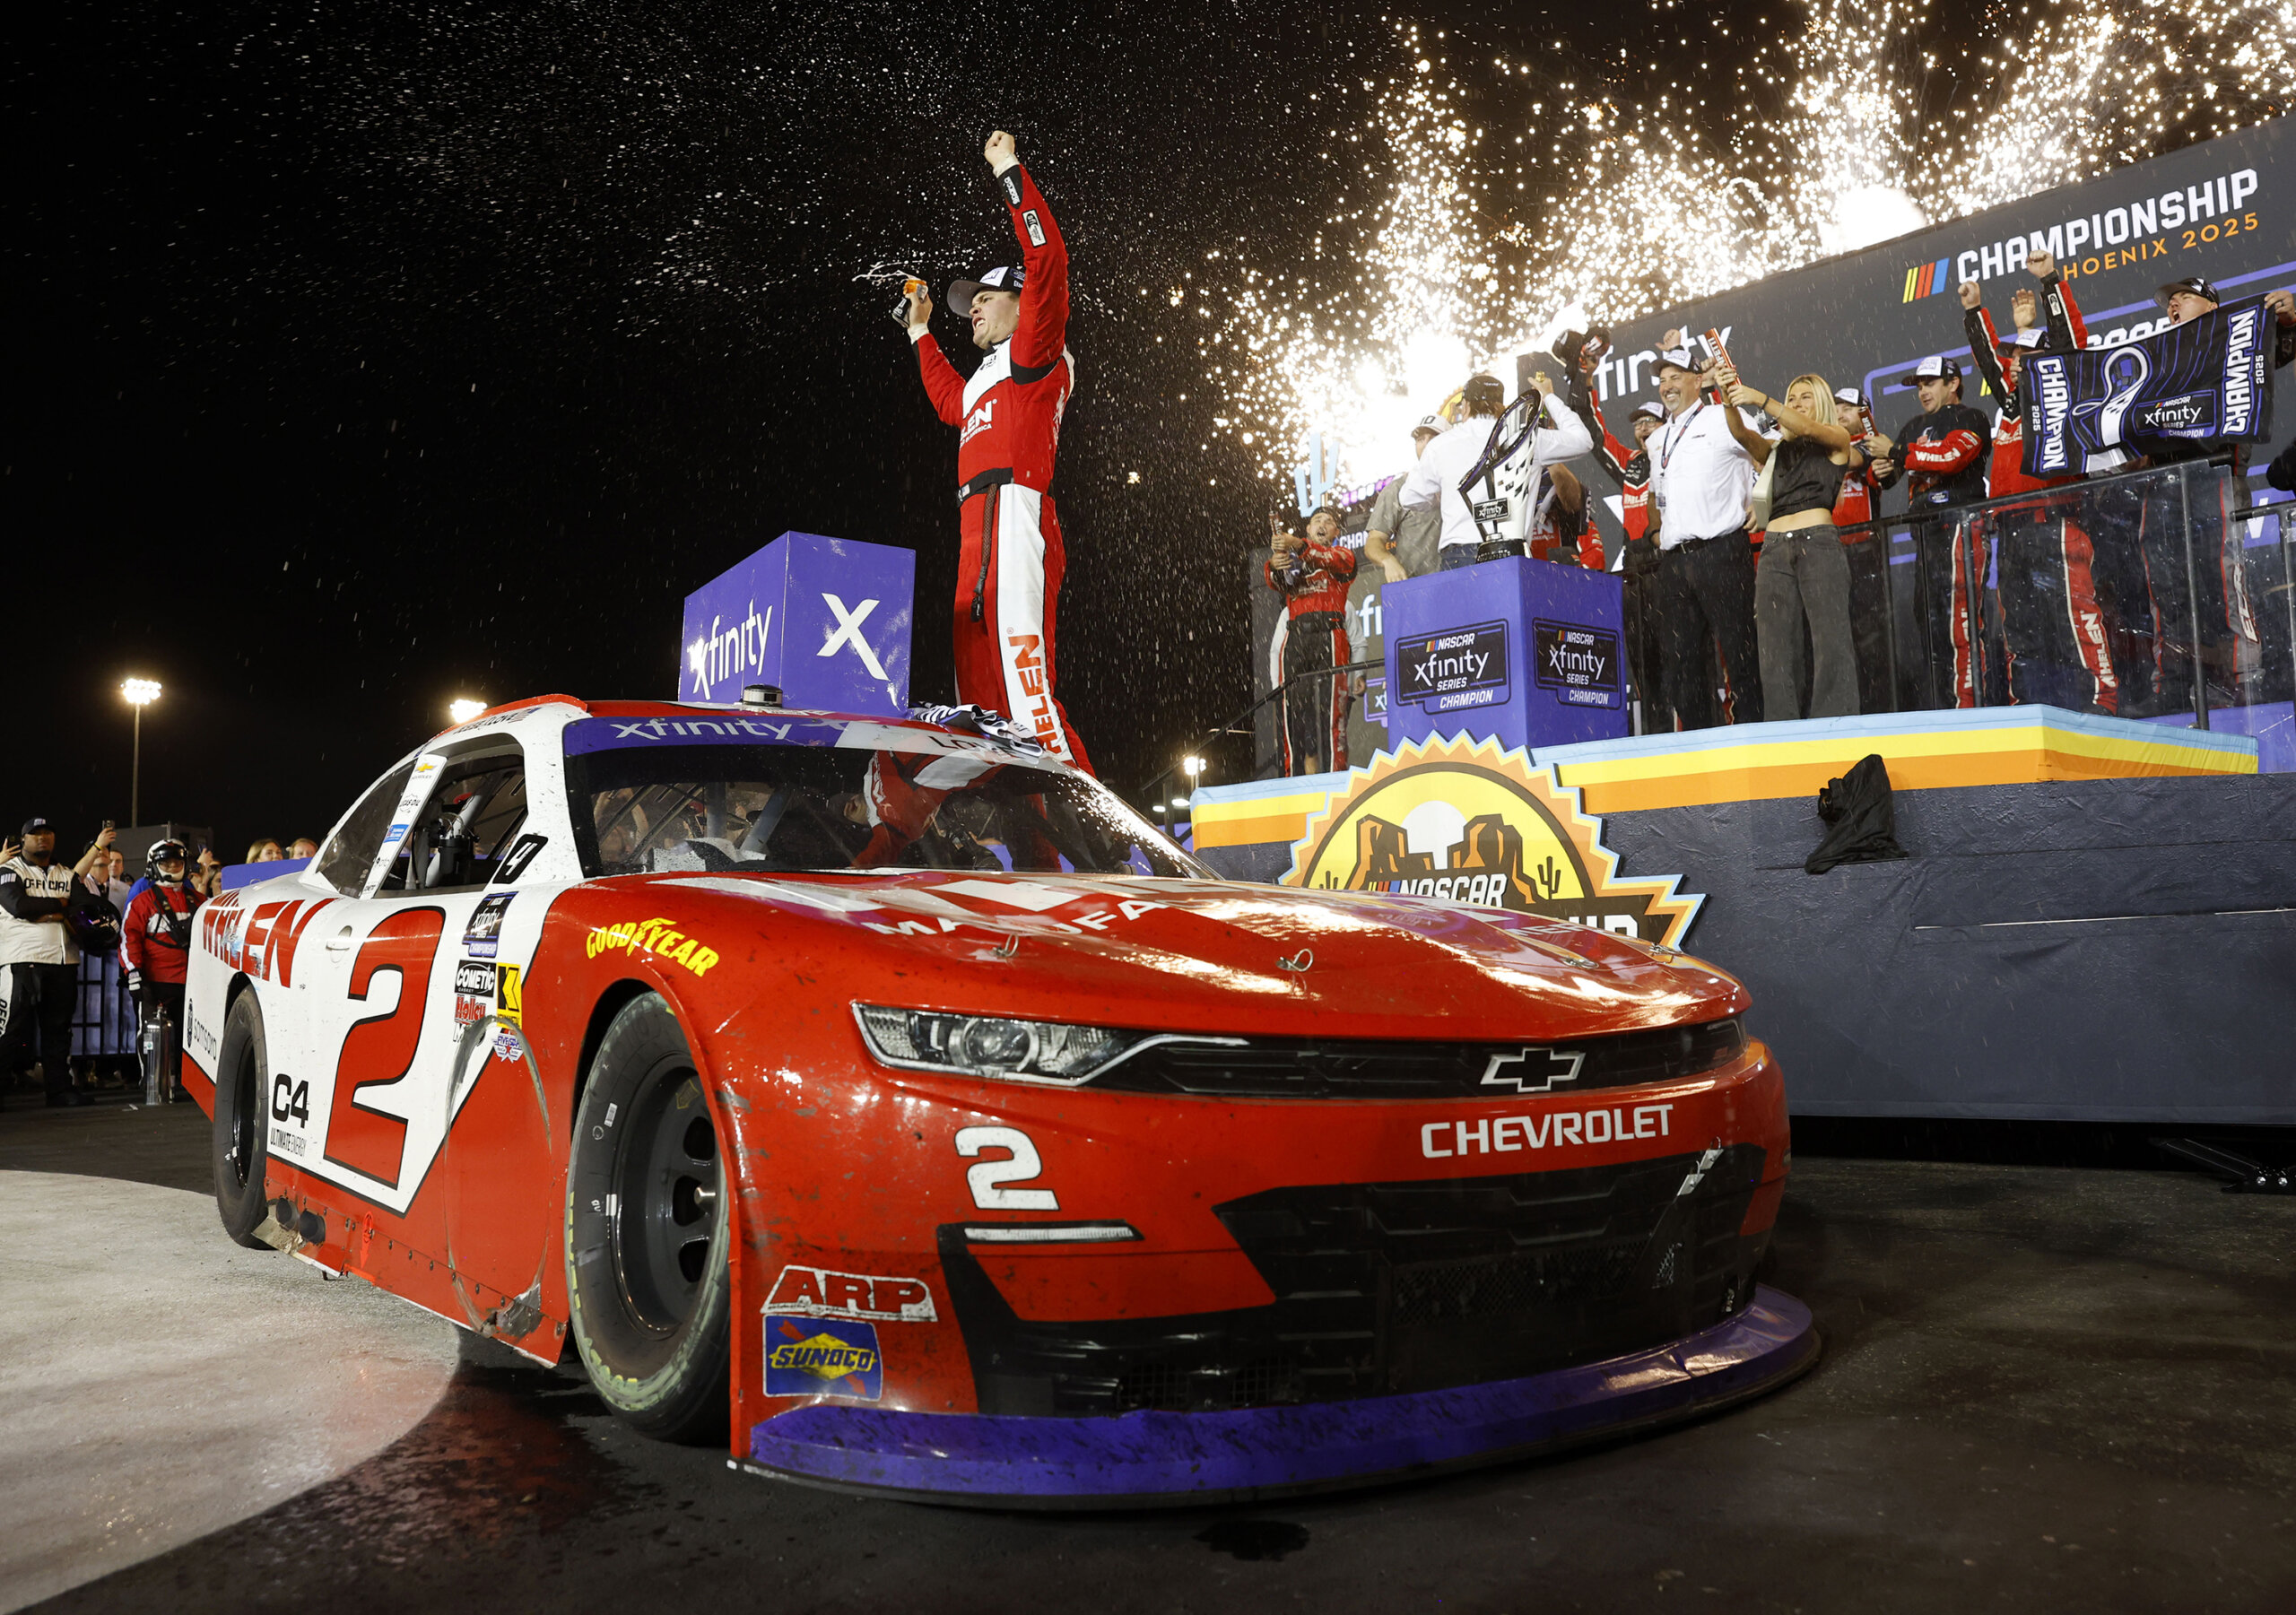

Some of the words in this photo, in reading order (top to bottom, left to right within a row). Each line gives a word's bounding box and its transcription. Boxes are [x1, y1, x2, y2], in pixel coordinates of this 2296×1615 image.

[1957, 169, 2258, 285] CHAMPIONSHIP
[2064, 238, 2168, 281] HOENIX
[2182, 213, 2259, 249] 2025
[1563, 325, 1732, 402] finty
[2222, 309, 2256, 434] CHAMPION
[2256, 355, 2265, 385] 2025
[2037, 358, 2066, 469] CHAMPION
[2144, 405, 2202, 427] xfinity
[2164, 395, 2191, 407] NASCAR
[1862, 415, 1875, 437] OTER
[2031, 405, 2041, 431] 2025
[2168, 429, 2205, 438] CHAMPION
[1915, 447, 1961, 462] WHELEN
[1479, 505, 1503, 518] xfinity
[688, 599, 773, 700] xfinity
[817, 593, 889, 682] X
[1438, 633, 1475, 650] NASCAR
[1566, 631, 1595, 646] NASCAR
[2081, 612, 2117, 688] WHELEN
[1414, 649, 1489, 687] xfinity
[1549, 644, 1605, 680] xfinity
[1008, 635, 1062, 754] HELEN
[1437, 677, 1467, 691] SERIES
[1566, 673, 1589, 685] SERIES
[1439, 690, 1493, 708] CHAMPION
[1569, 690, 1609, 705] CHAMPION
[611, 717, 794, 741] xfinity
[587, 917, 719, 977] GOODYEAR
[456, 968, 495, 991] COMETIC
[324, 906, 446, 1190] 2
[272, 1073, 309, 1129] C4
[1421, 1104, 1674, 1159] CHEVROLET
[954, 1125, 1061, 1211] 2
[766, 1267, 928, 1315] ARP
[777, 1346, 874, 1369] SUNOCO
